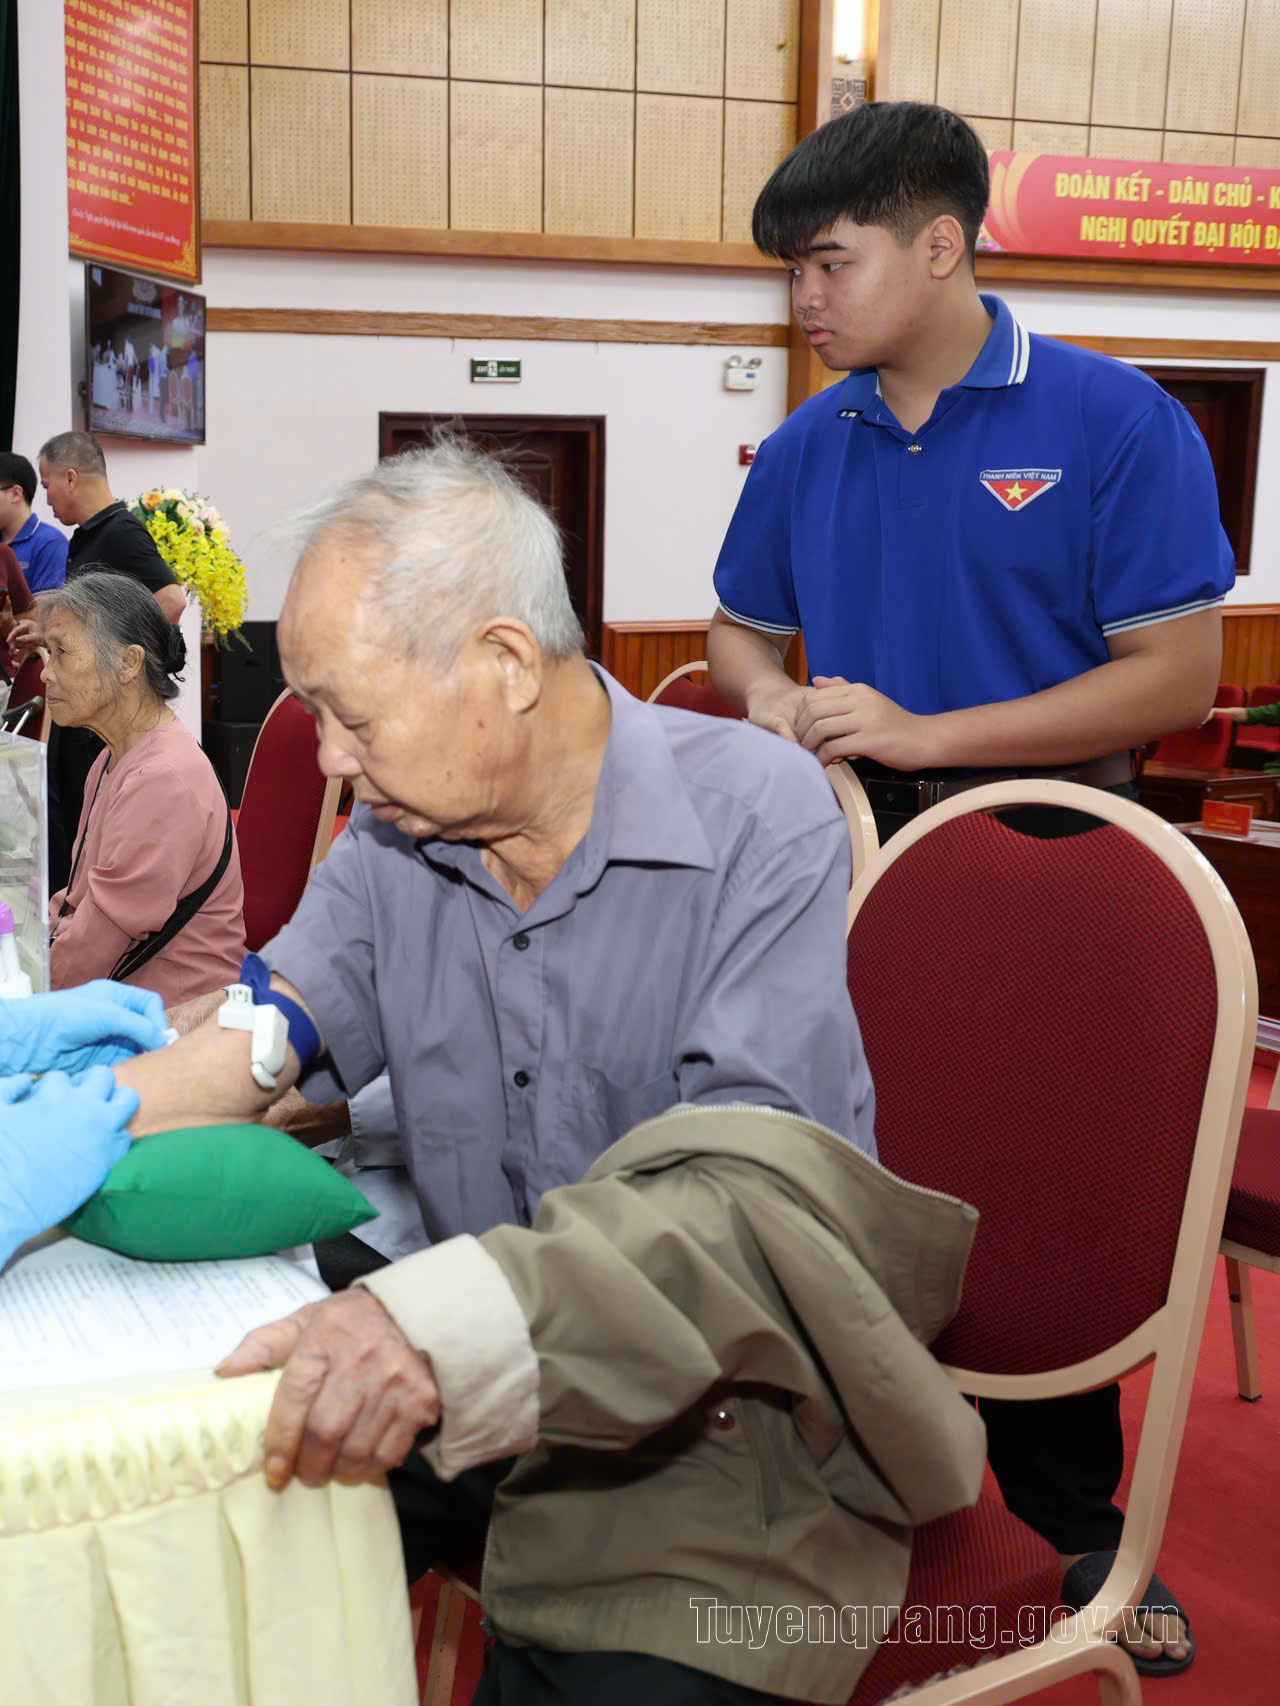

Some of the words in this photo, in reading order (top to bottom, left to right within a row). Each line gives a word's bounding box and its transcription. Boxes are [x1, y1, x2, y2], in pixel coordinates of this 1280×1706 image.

[1055, 169, 1111, 199] ĐOÀN
[1115, 170, 1152, 202] KẾT
[1169, 175, 1210, 206] DÂN
[1214, 175, 1253, 208] CHỦ
[1080, 215, 1127, 248] NGHỊ
[1131, 213, 1190, 247] QUYẾT
[1194, 220, 1226, 253] ĐẠI
[1230, 218, 1262, 255] HỘI
[1265, 224, 1280, 250] Đ
[983, 472, 1005, 480] THANH
[1005, 471, 1022, 480] NIÊN
[1023, 471, 1040, 480] VIỆT
[1040, 472, 1057, 481] NAM
